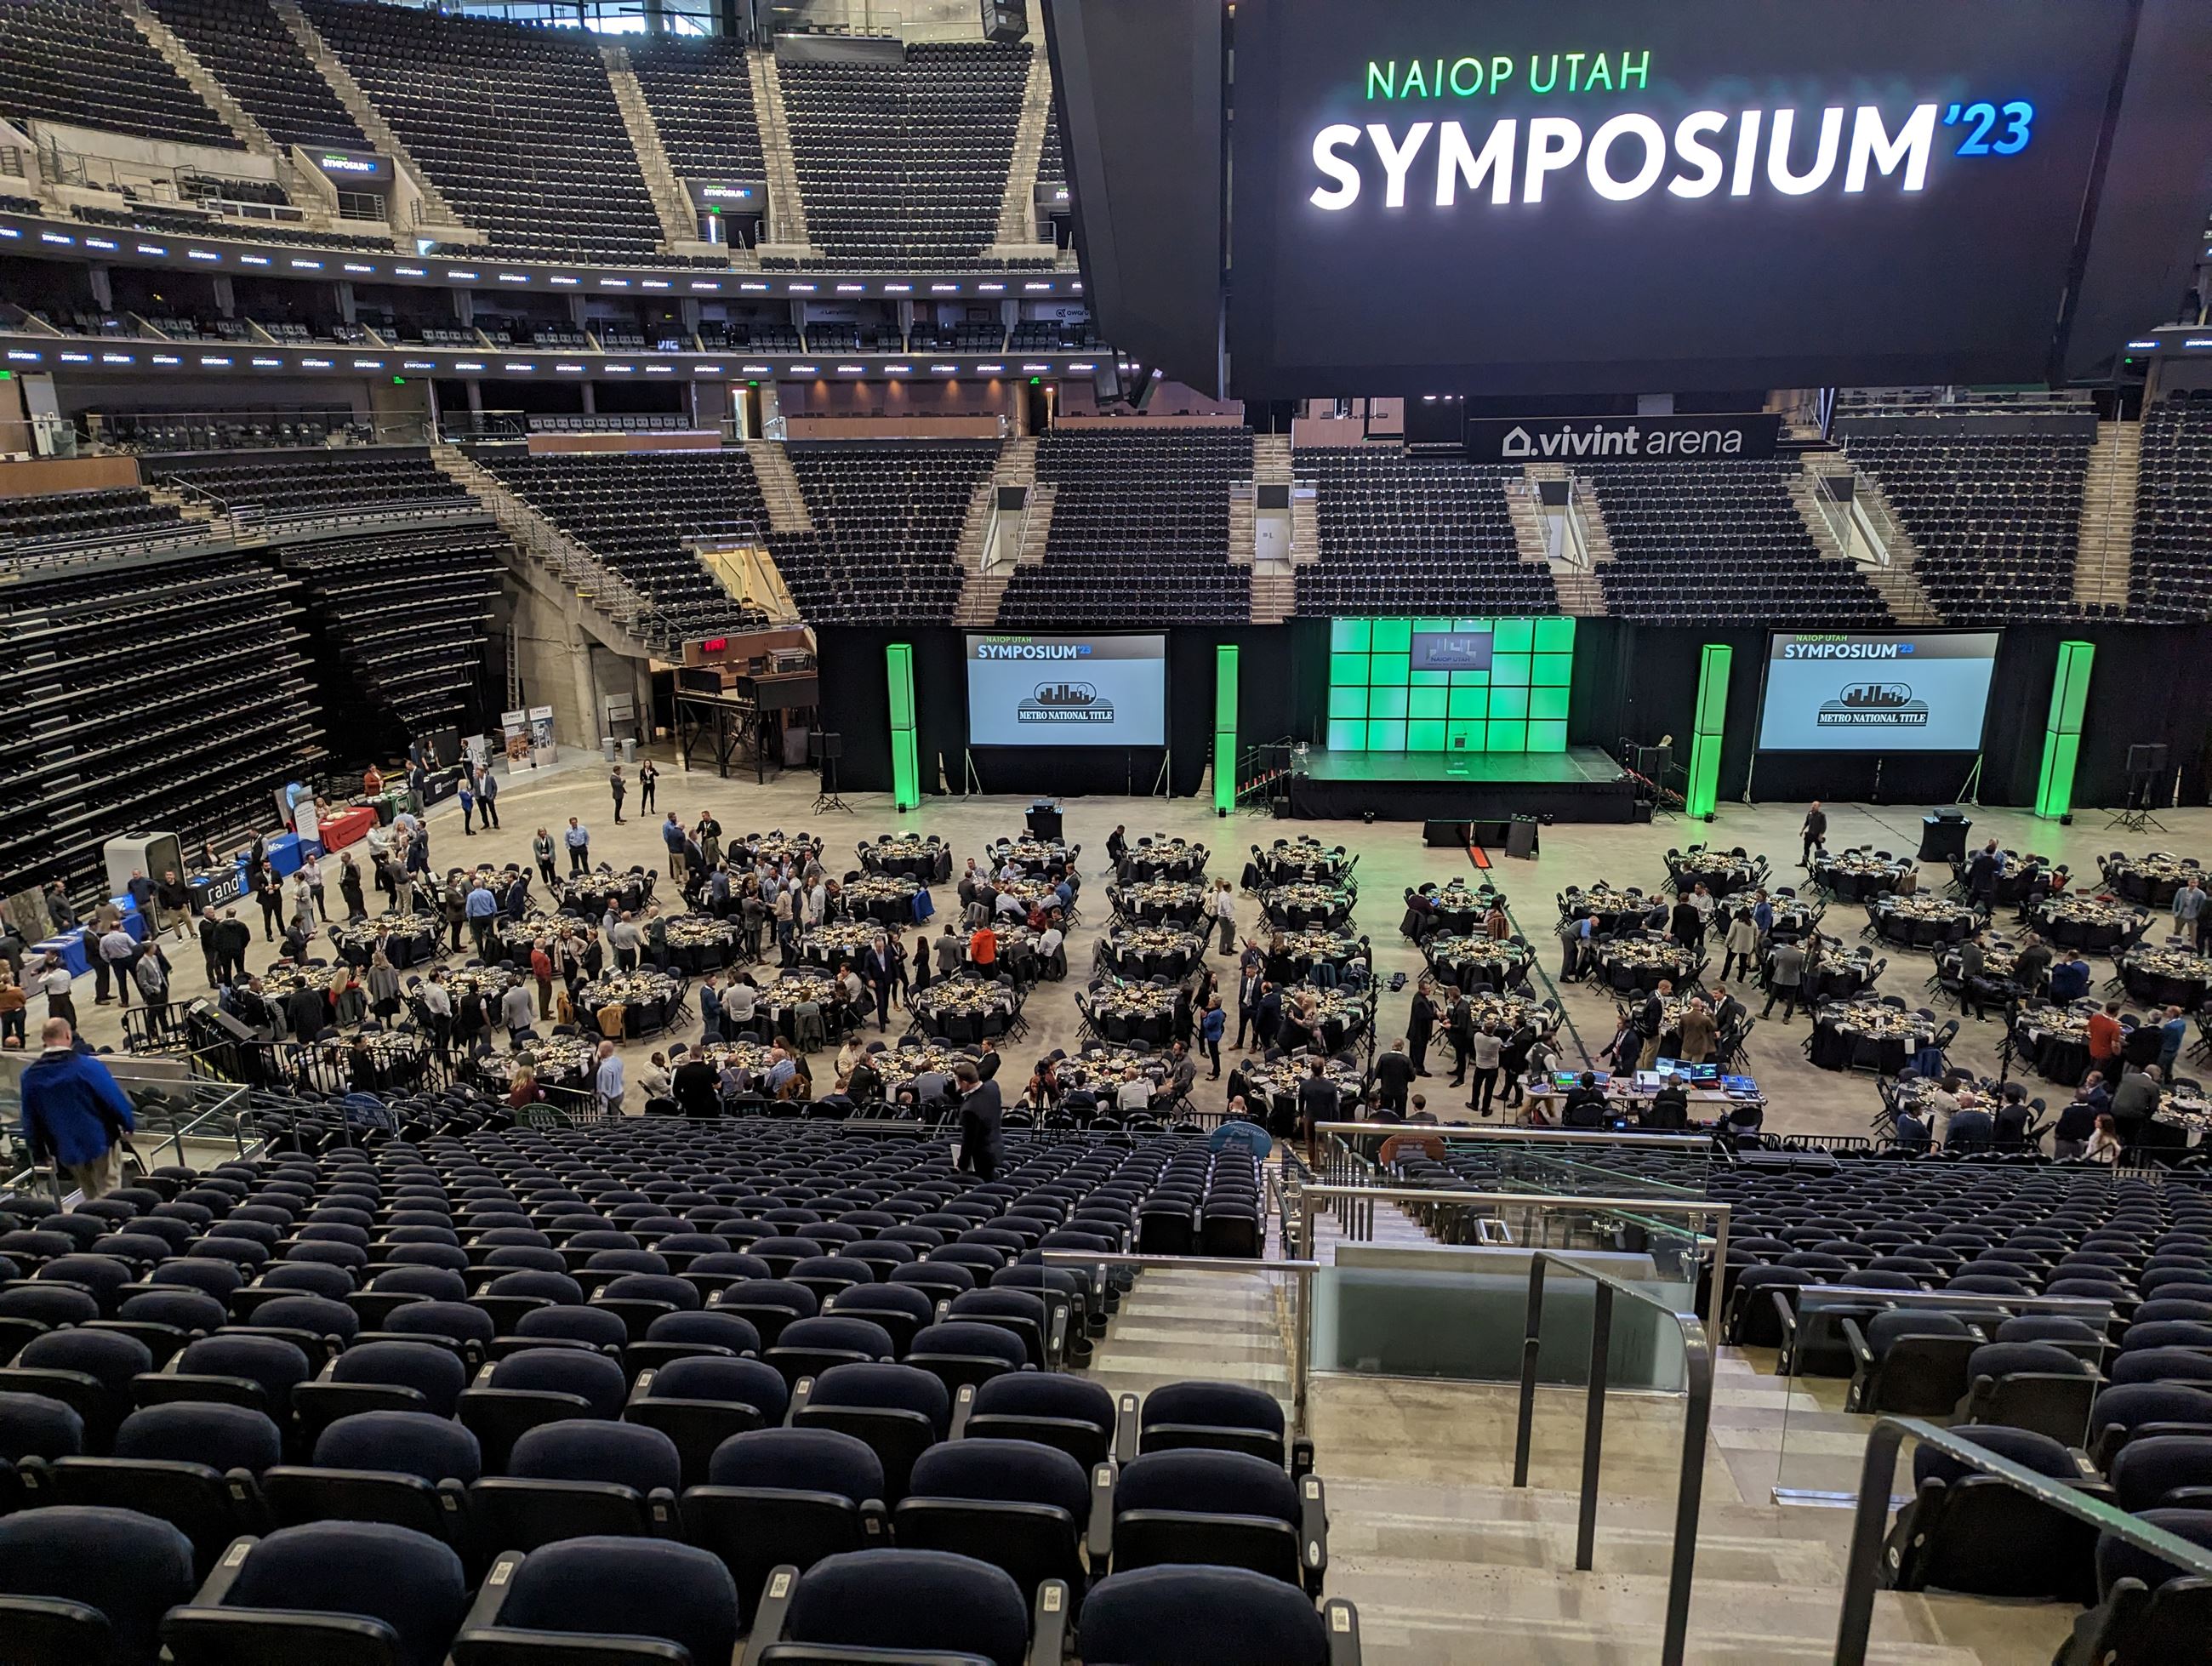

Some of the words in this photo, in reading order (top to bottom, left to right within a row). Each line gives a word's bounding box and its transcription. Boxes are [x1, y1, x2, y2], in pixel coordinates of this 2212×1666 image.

[1366, 56, 1514, 100] NAIOP
[1530, 50, 1650, 94] UTAH
[1308, 103, 1938, 211] SYMPOSIUM
[1944, 101, 2034, 157] '23
[322, 158, 368, 171] SYMPOSIUM
[704, 189, 744, 197] SYMPOSIUM
[1646, 430, 1742, 454] arena
[978, 645, 1077, 659] SYMPOSIUM
[1077, 645, 1092, 654] '23
[1784, 643, 1897, 658] SYMPOSIUM
[1898, 644, 1914, 653] '23
[1019, 710, 1047, 720] METRO
[1048, 710, 1088, 720] NATIONAL
[1089, 710, 1113, 720] TITLE
[1819, 713, 1851, 723] METRO
[1852, 713, 1897, 723] NATIONAL
[1899, 713, 1926, 723] TITLE
